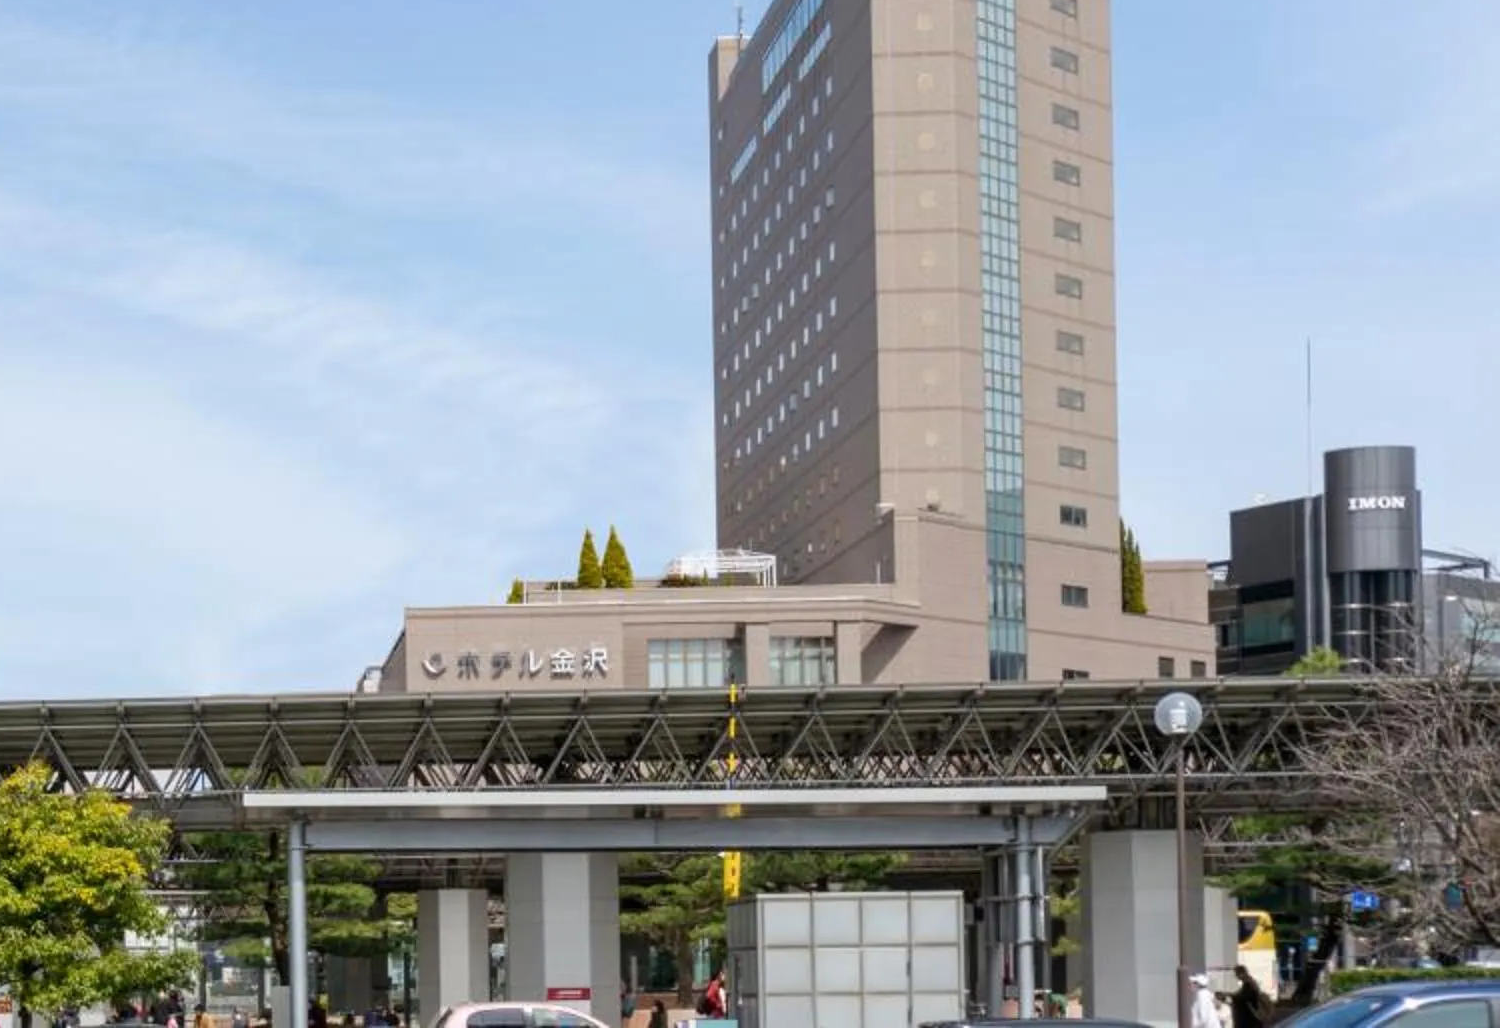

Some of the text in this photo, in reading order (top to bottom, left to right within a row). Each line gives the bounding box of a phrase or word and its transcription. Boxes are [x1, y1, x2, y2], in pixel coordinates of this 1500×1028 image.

[1347, 494, 1406, 511] IMON
[457, 645, 609, 678] ホテル金沢
